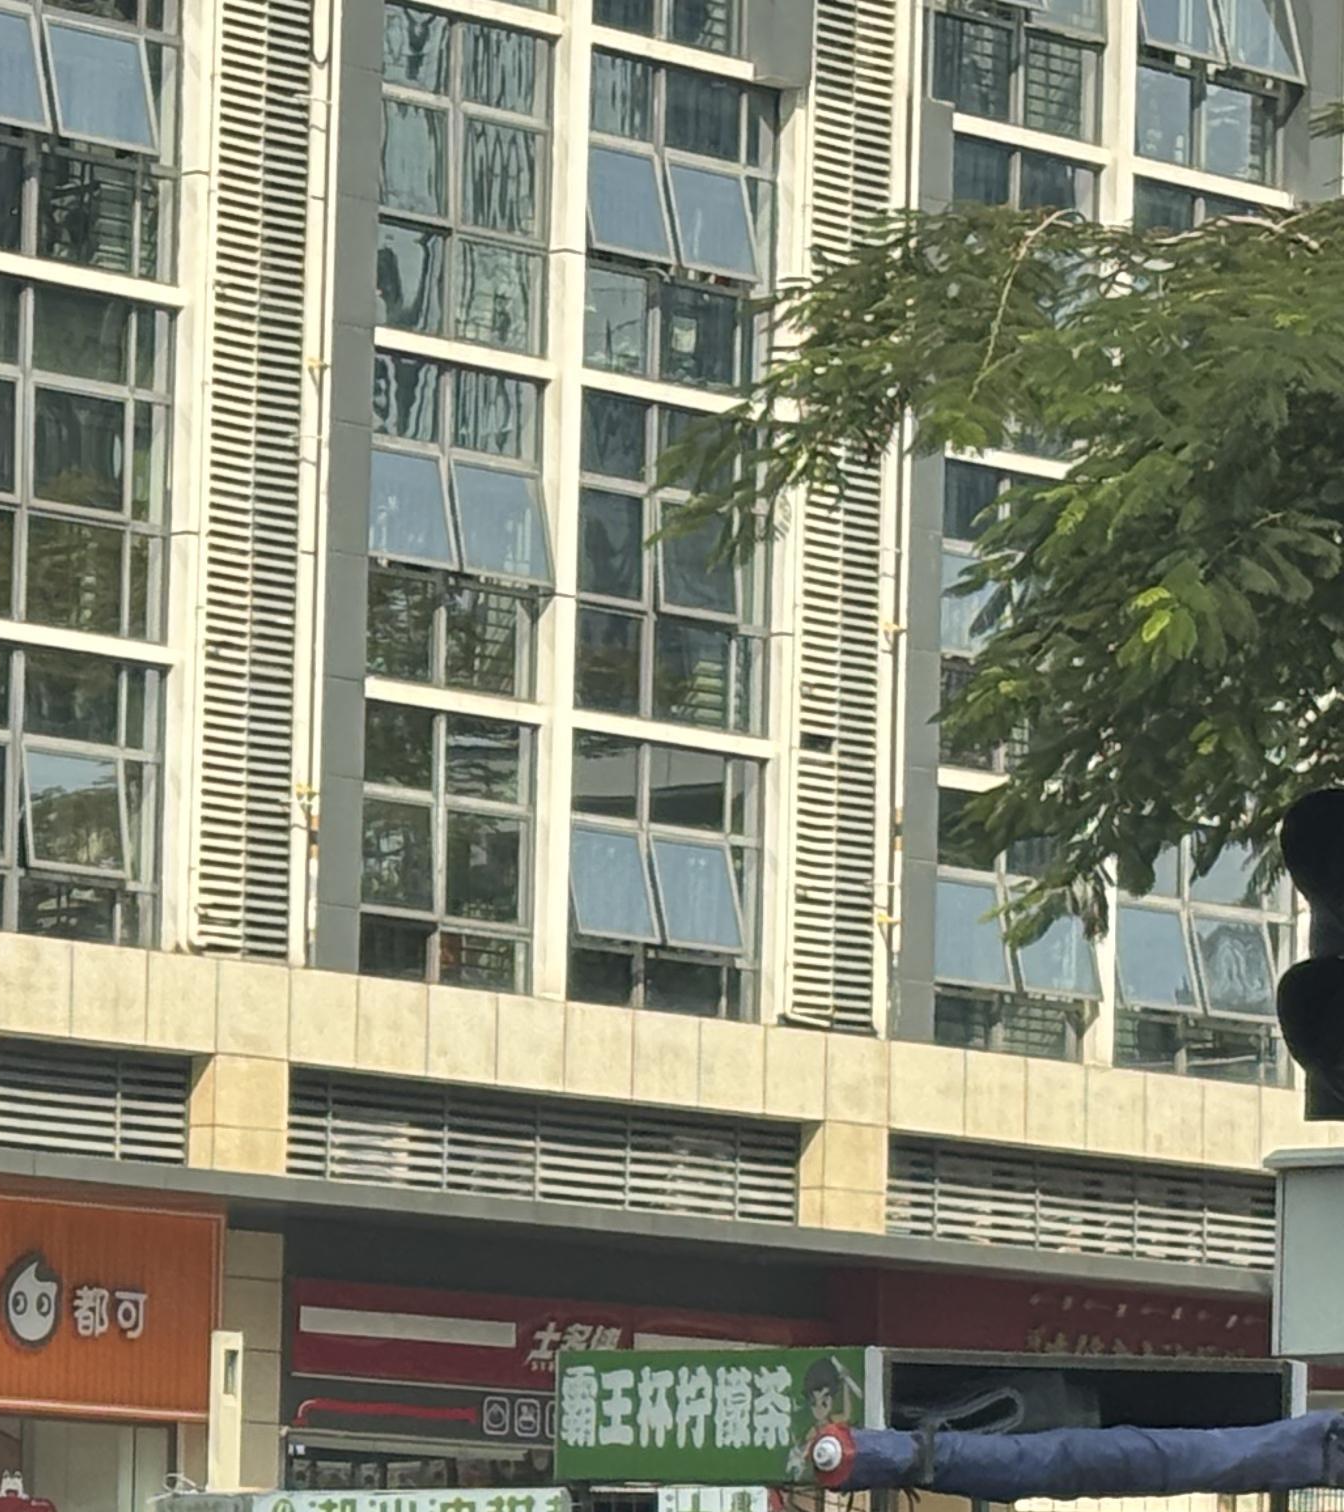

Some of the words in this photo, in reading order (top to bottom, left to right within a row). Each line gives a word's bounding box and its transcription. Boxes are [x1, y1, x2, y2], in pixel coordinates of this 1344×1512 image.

[73, 1286, 148, 1340] 都可
[560, 1364, 793, 1450] 霸王杯柠檬茶
